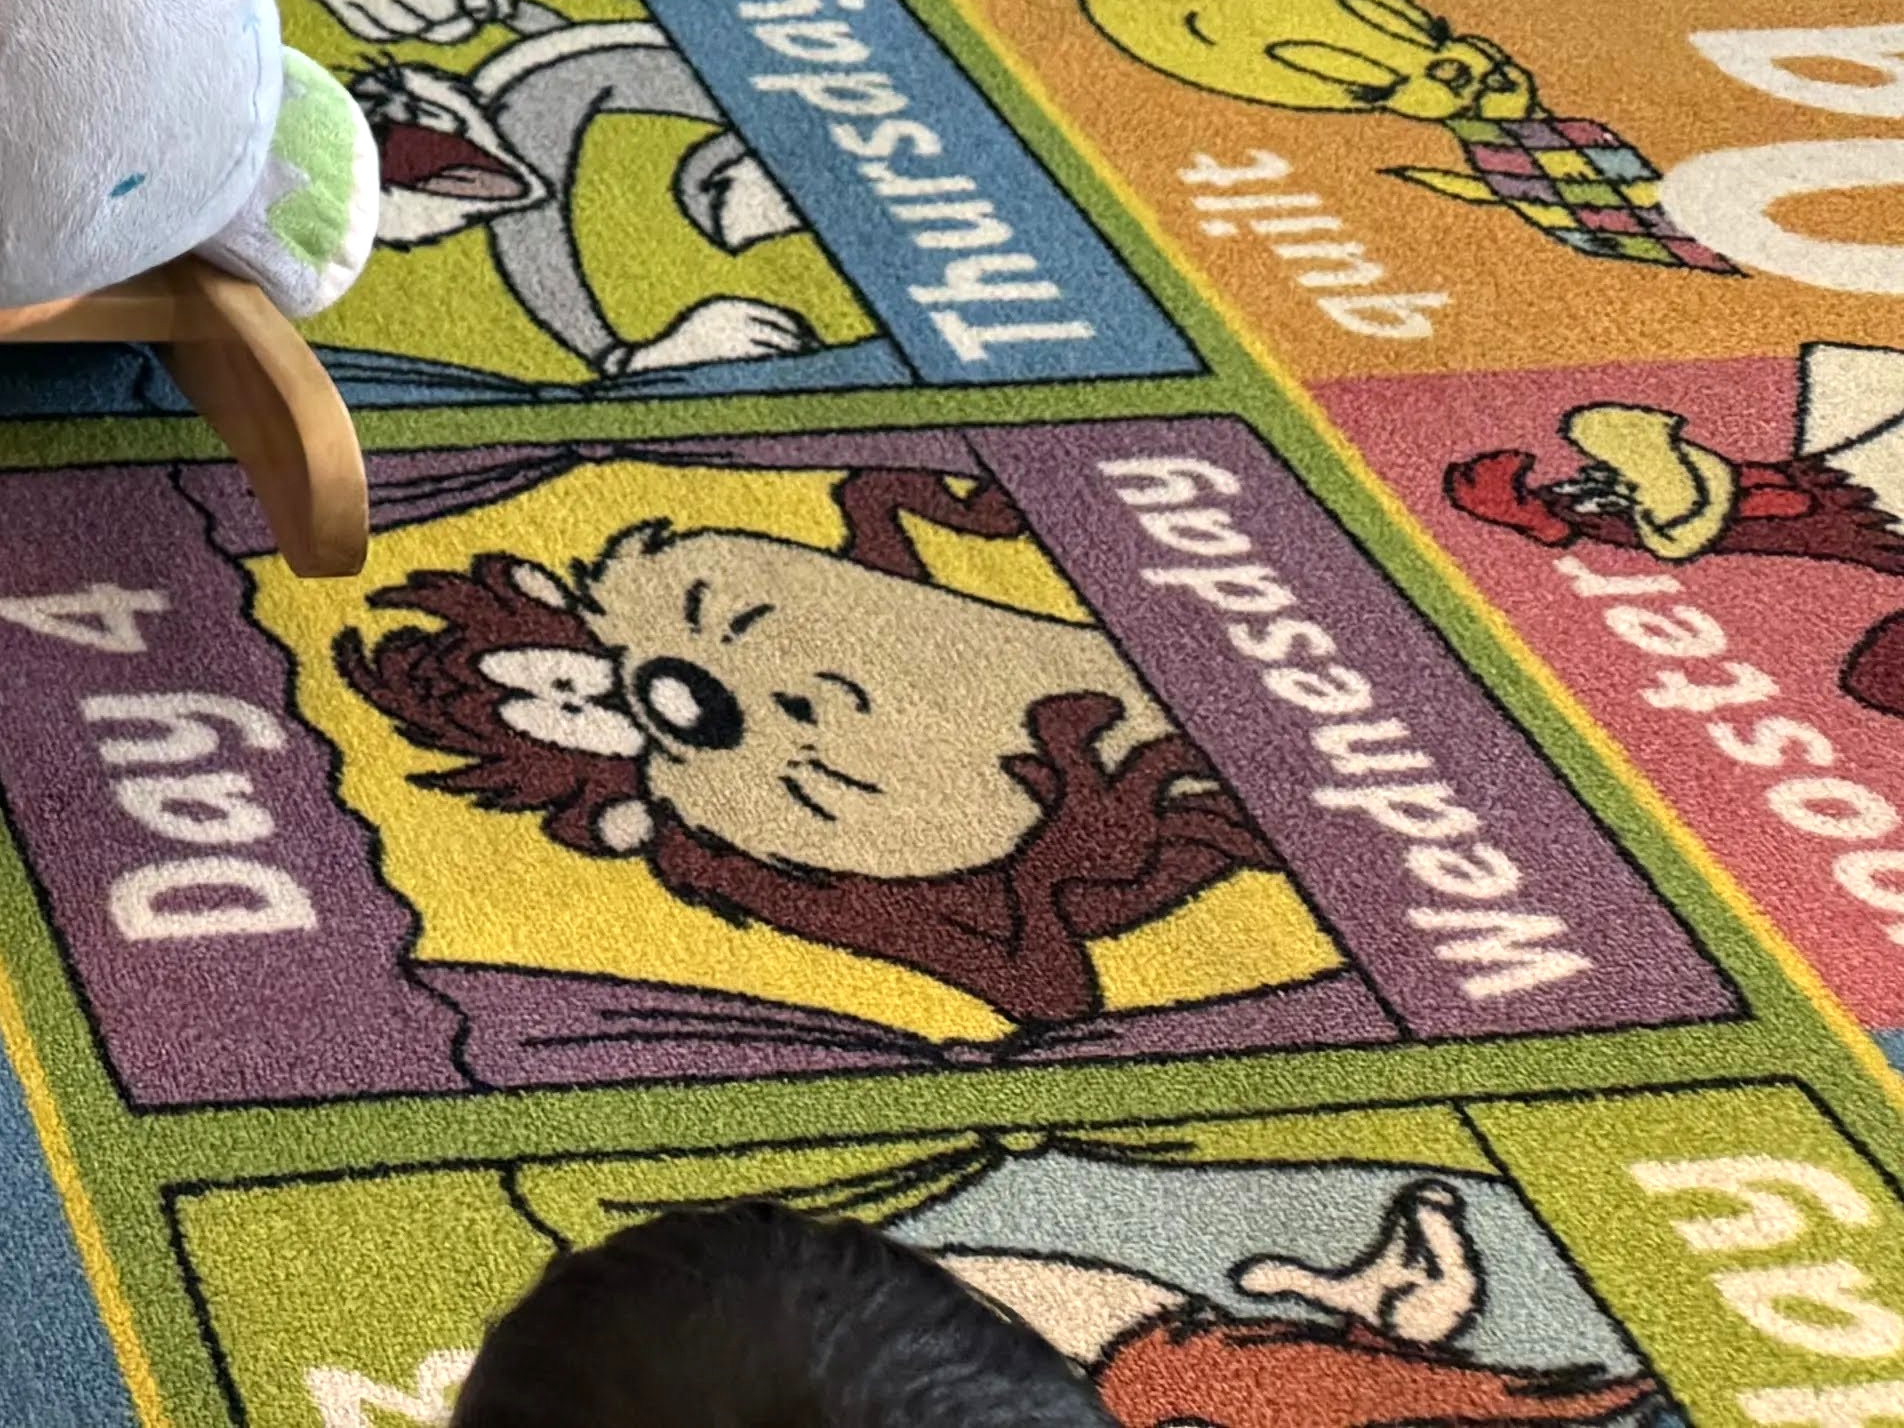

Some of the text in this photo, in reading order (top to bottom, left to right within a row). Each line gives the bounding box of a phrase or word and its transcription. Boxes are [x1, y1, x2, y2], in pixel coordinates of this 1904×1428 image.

[1177, 147, 1454, 342] quilt
[80, 692, 317, 942] Day
[1096, 456, 1594, 1001] Wednesday
[1554, 555, 1904, 946] ooster
